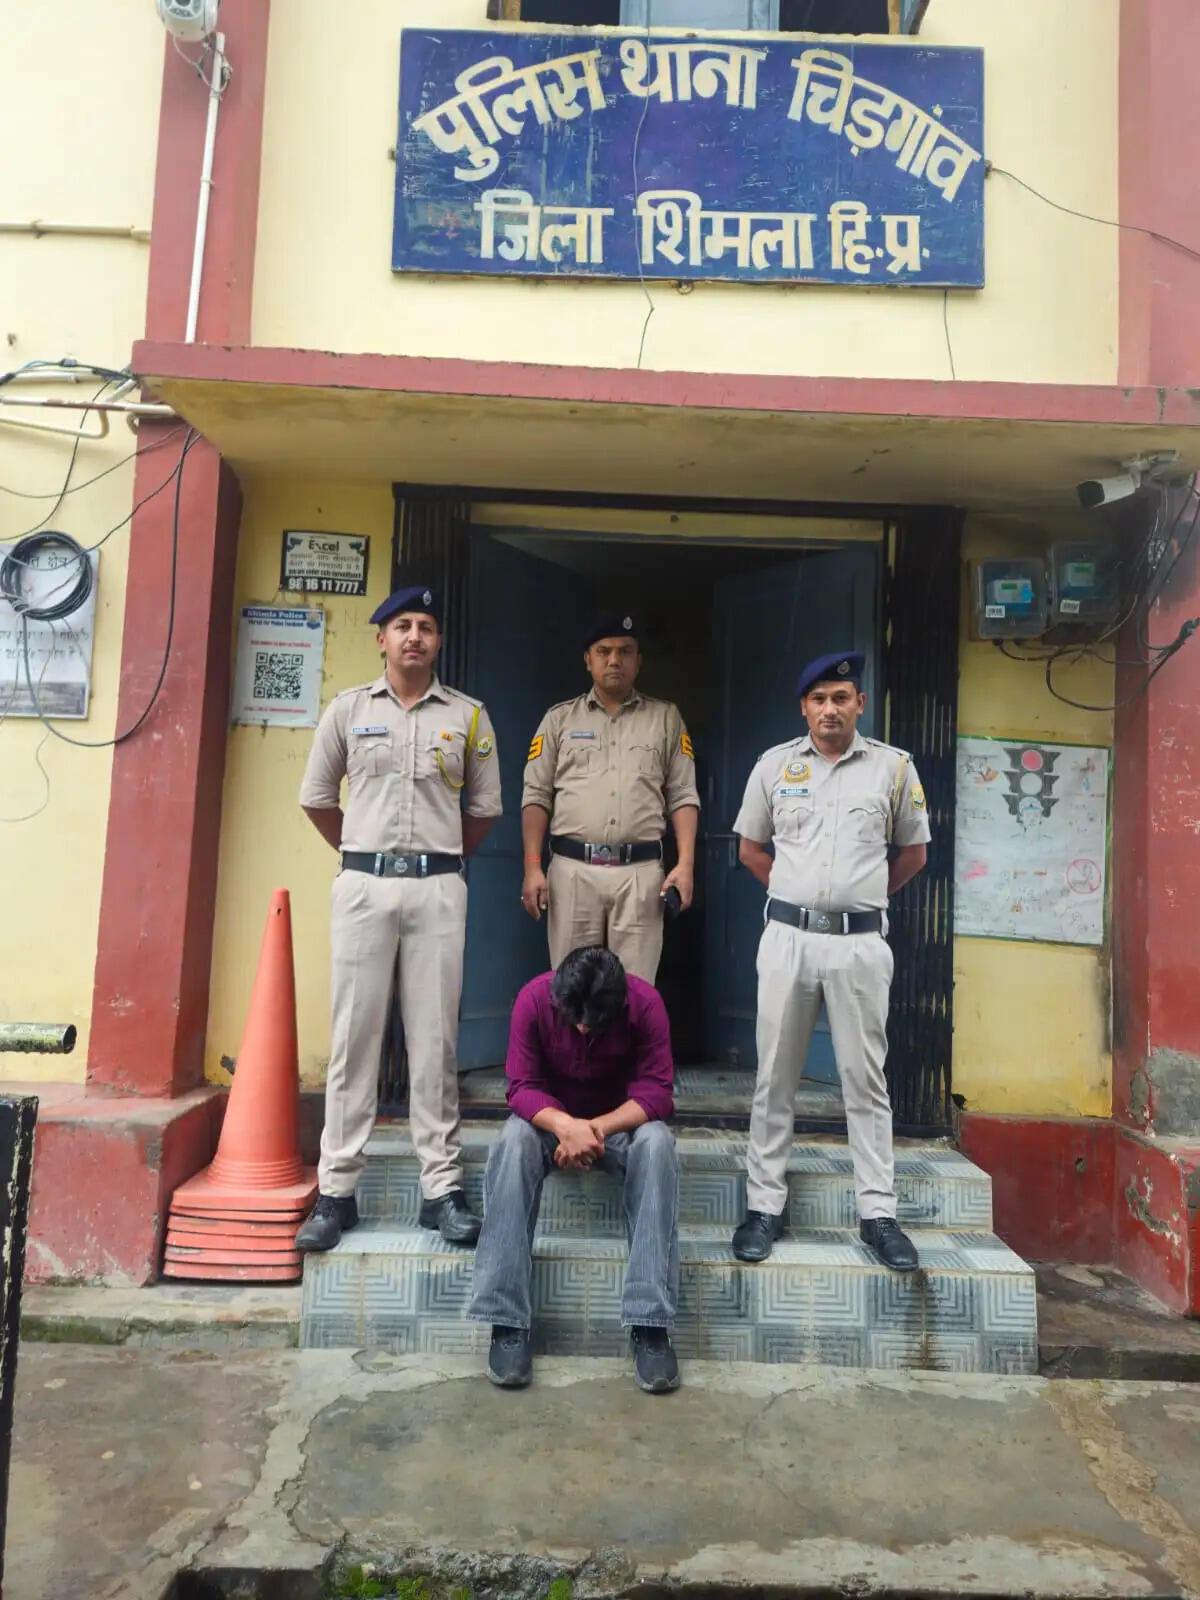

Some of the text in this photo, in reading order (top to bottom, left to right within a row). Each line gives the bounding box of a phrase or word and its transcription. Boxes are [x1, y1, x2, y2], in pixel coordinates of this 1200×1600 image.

[411, 39, 982, 203] पुलिस थाना चिड़गांव
[473, 188, 614, 264] जिला
[632, 189, 816, 271] शिमला
[308, 539, 340, 552] Excel
